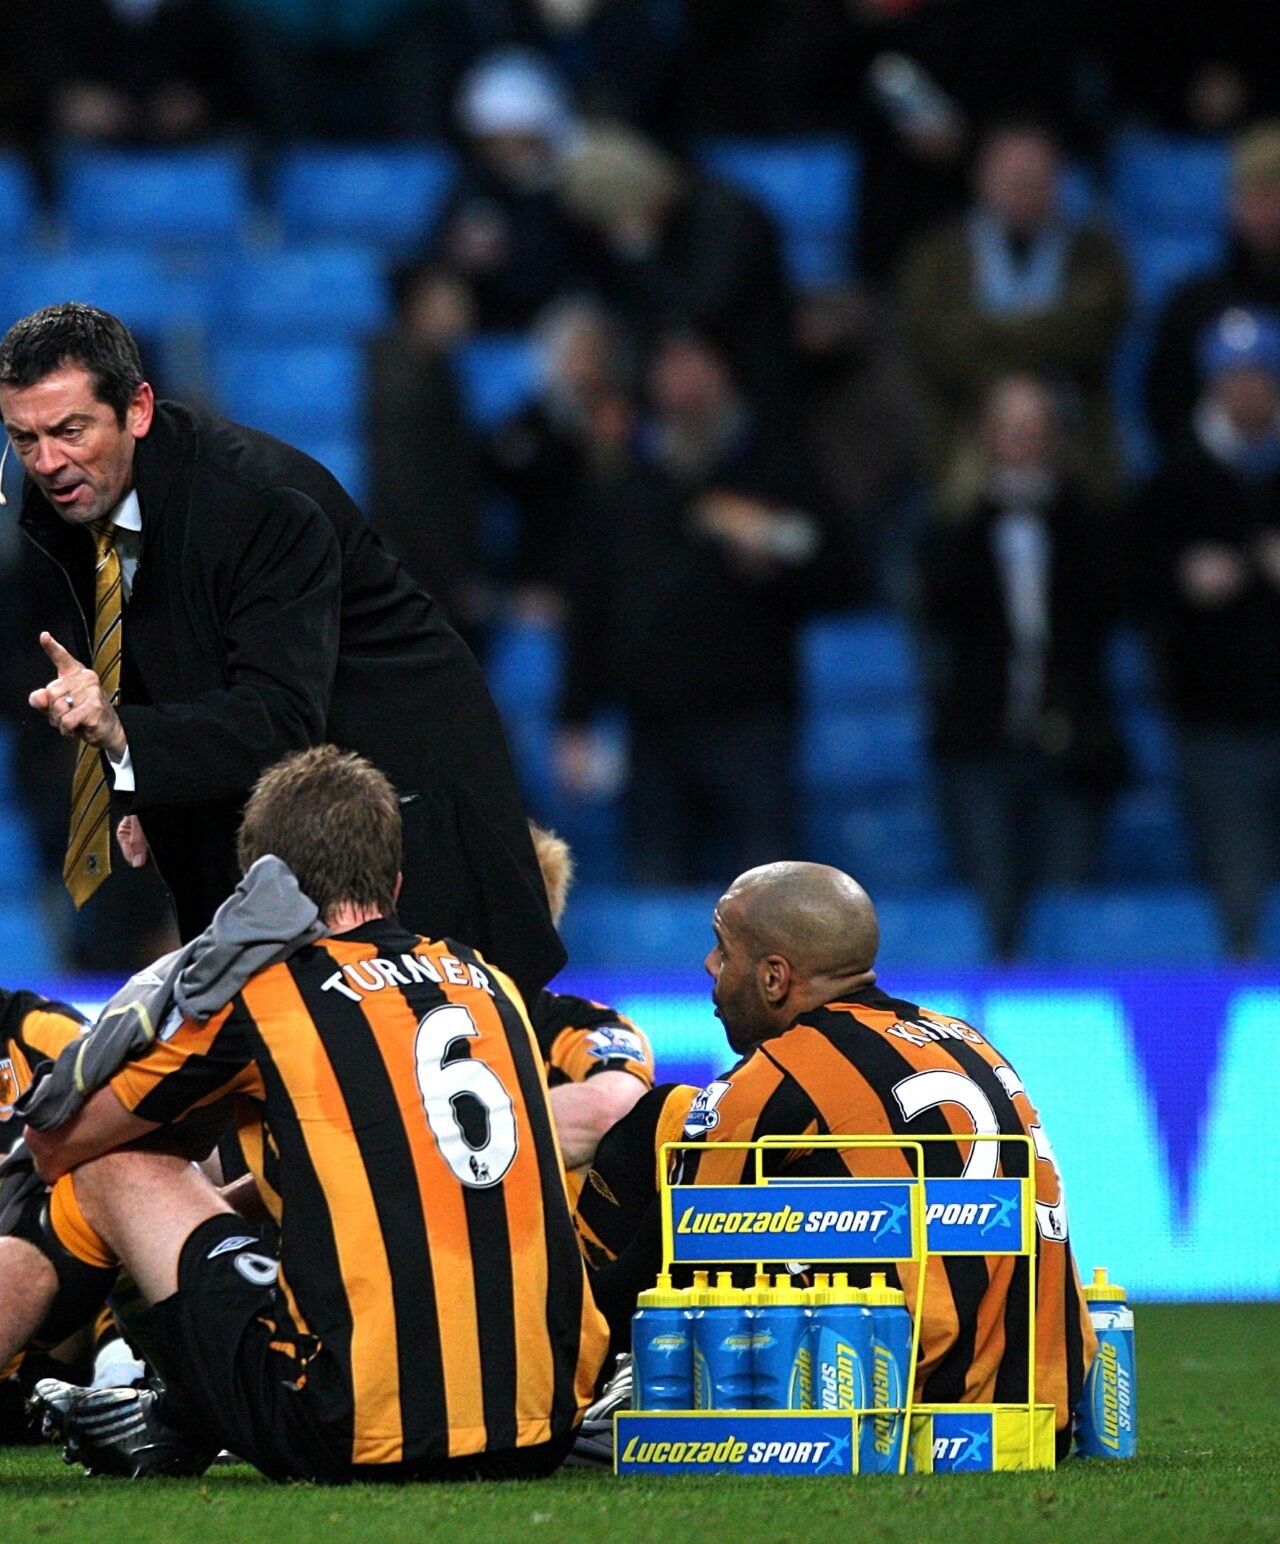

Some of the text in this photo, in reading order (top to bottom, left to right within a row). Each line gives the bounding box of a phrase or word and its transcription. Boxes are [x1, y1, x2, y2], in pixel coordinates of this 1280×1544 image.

[321, 954, 496, 1002] TURNER
[886, 1019, 983, 1048] KING
[414, 1004, 519, 1189] 6
[677, 1205, 888, 1234] Lucozade SPORT
[821, 1363, 837, 1410] SPO
[837, 1342, 858, 1410] Lucoz
[1097, 1342, 1119, 1450] Lucozade
[1118, 1362, 1131, 1432] SPORT
[622, 1436, 830, 1463] Lucozade SPORT
